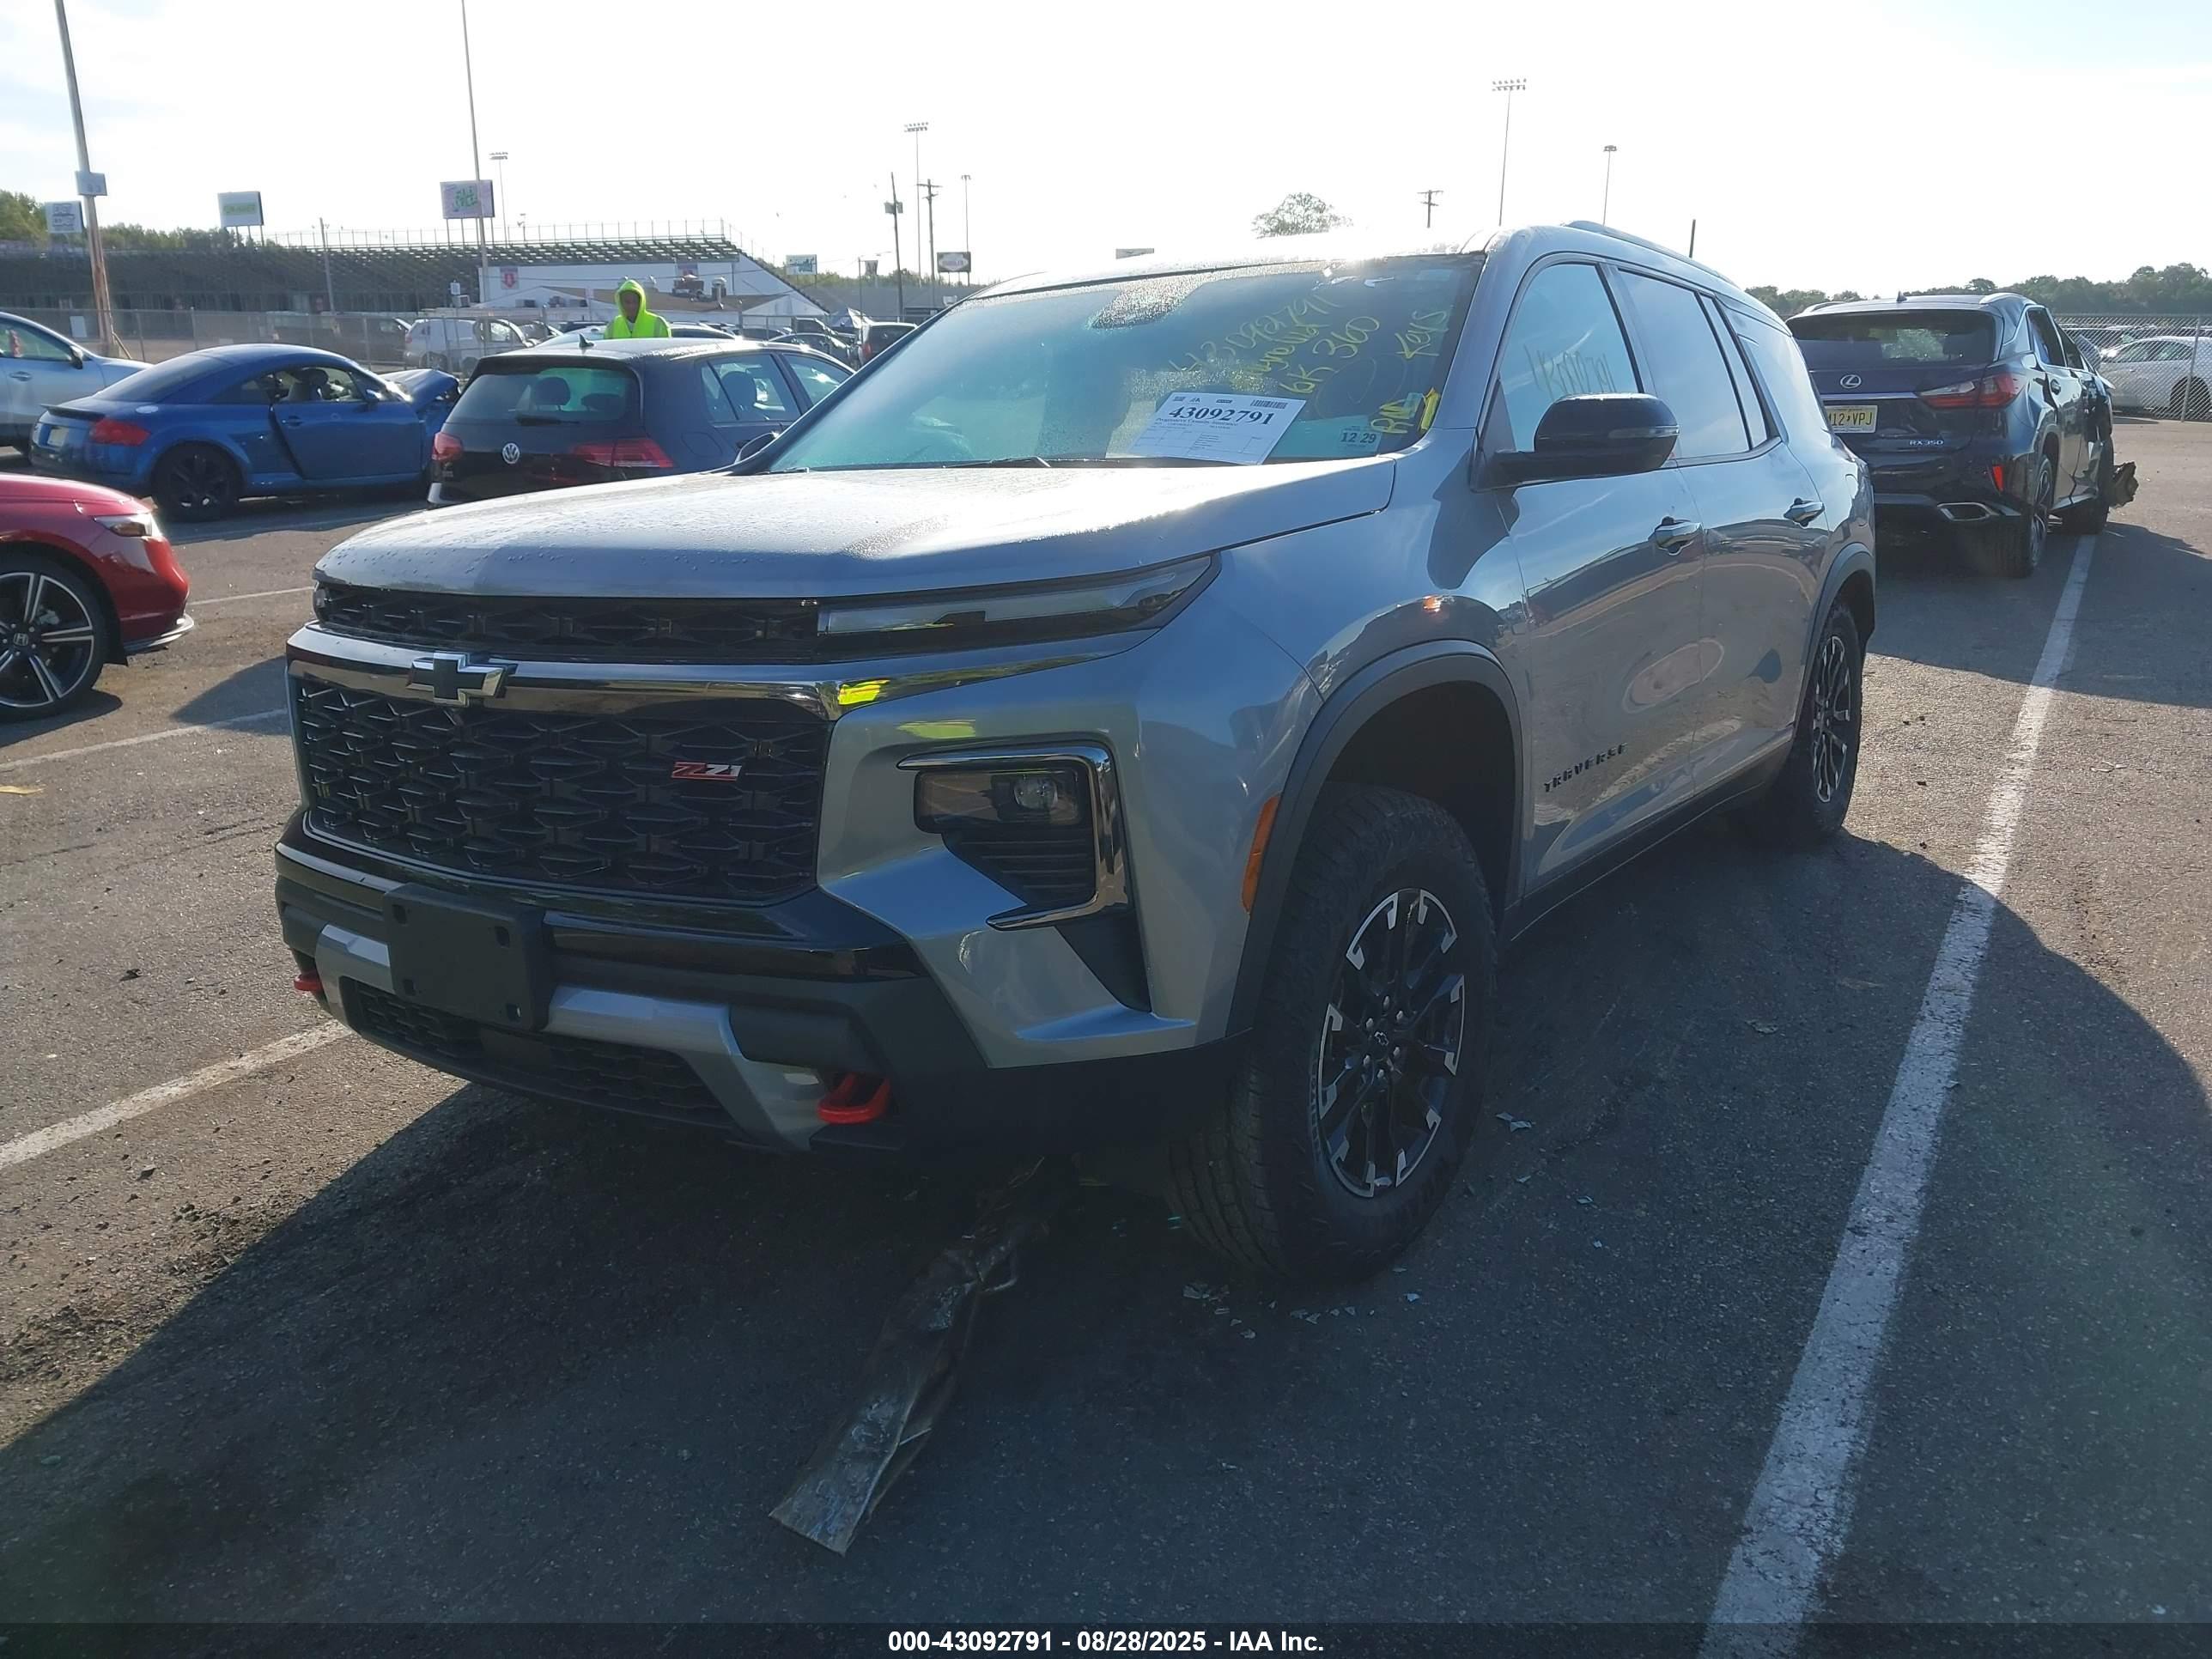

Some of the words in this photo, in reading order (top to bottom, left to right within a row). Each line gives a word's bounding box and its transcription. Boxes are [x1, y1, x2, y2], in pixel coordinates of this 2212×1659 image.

[1169, 405, 1276, 425] 43092791
[1340, 432, 1358, 443] 12
[1359, 432, 1377, 444] 29
[1543, 741, 1628, 793] TRAVERSE
